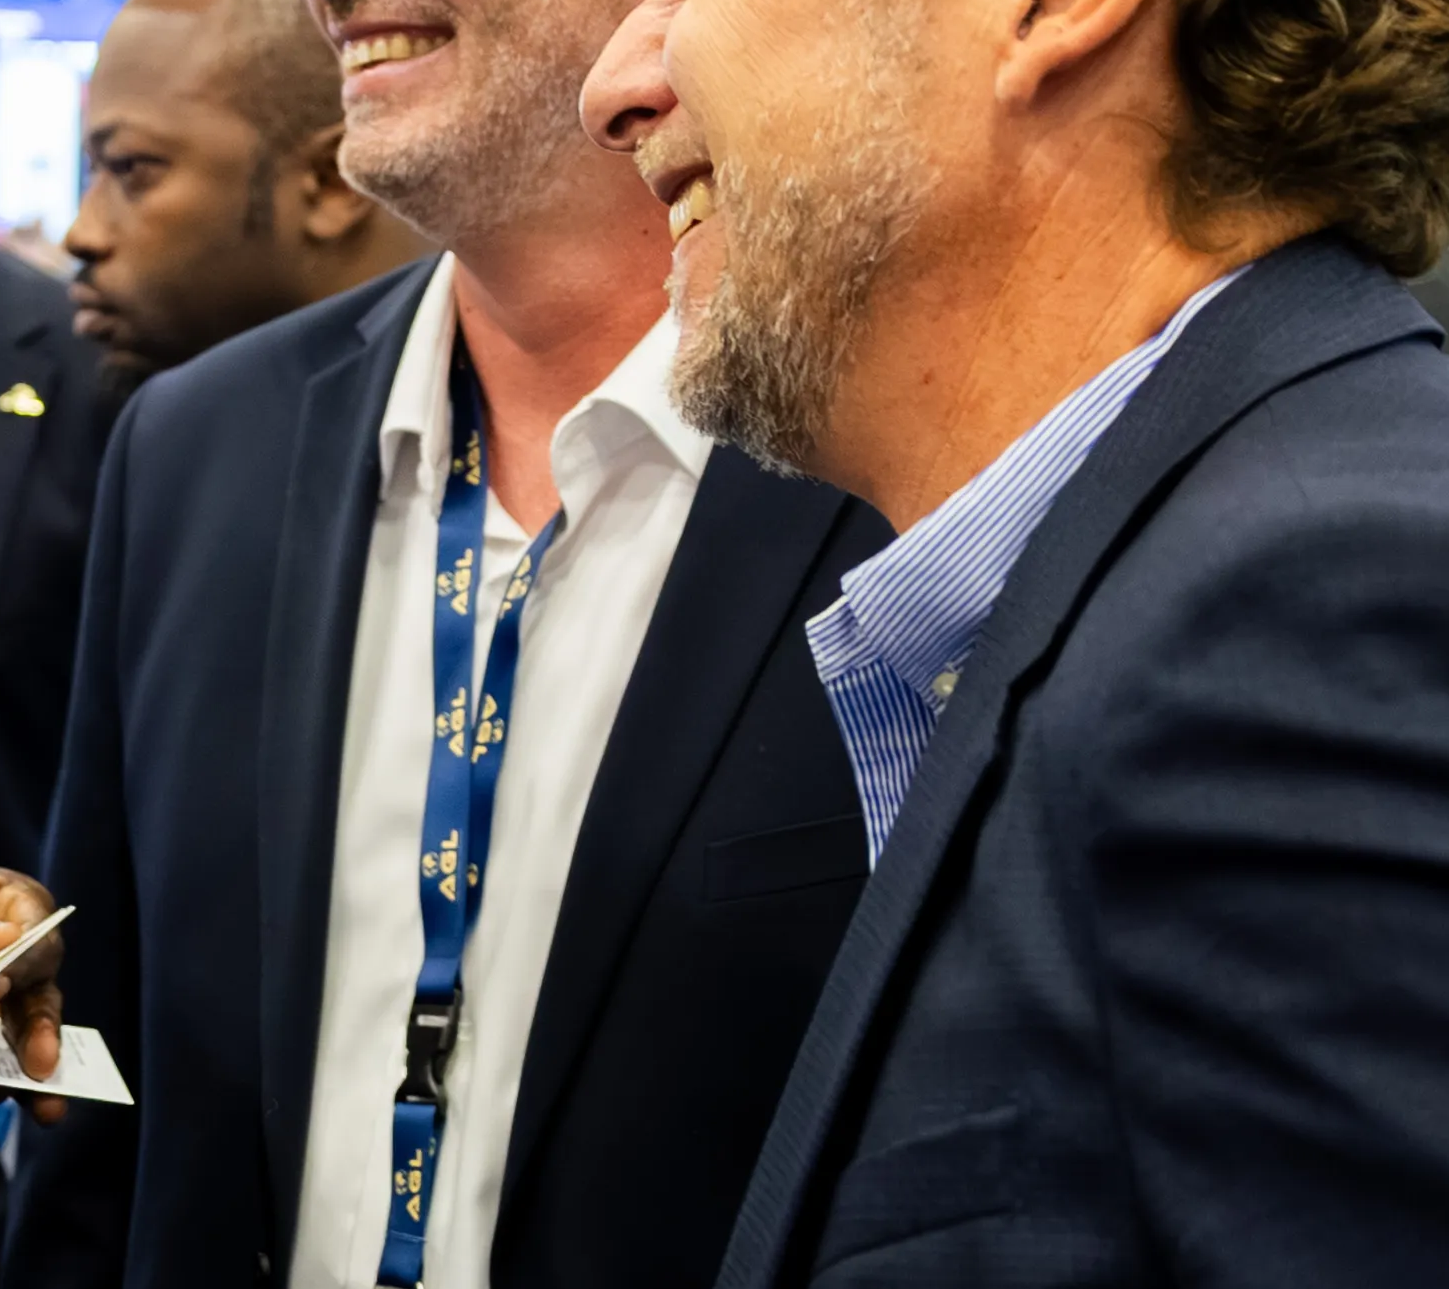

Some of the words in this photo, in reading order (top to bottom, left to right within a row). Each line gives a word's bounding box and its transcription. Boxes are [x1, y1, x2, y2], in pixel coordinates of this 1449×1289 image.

[451, 548, 474, 616] AGL
[448, 686, 467, 758] AGL
[437, 828, 460, 903] AGL
[405, 1148, 423, 1222] AGL
